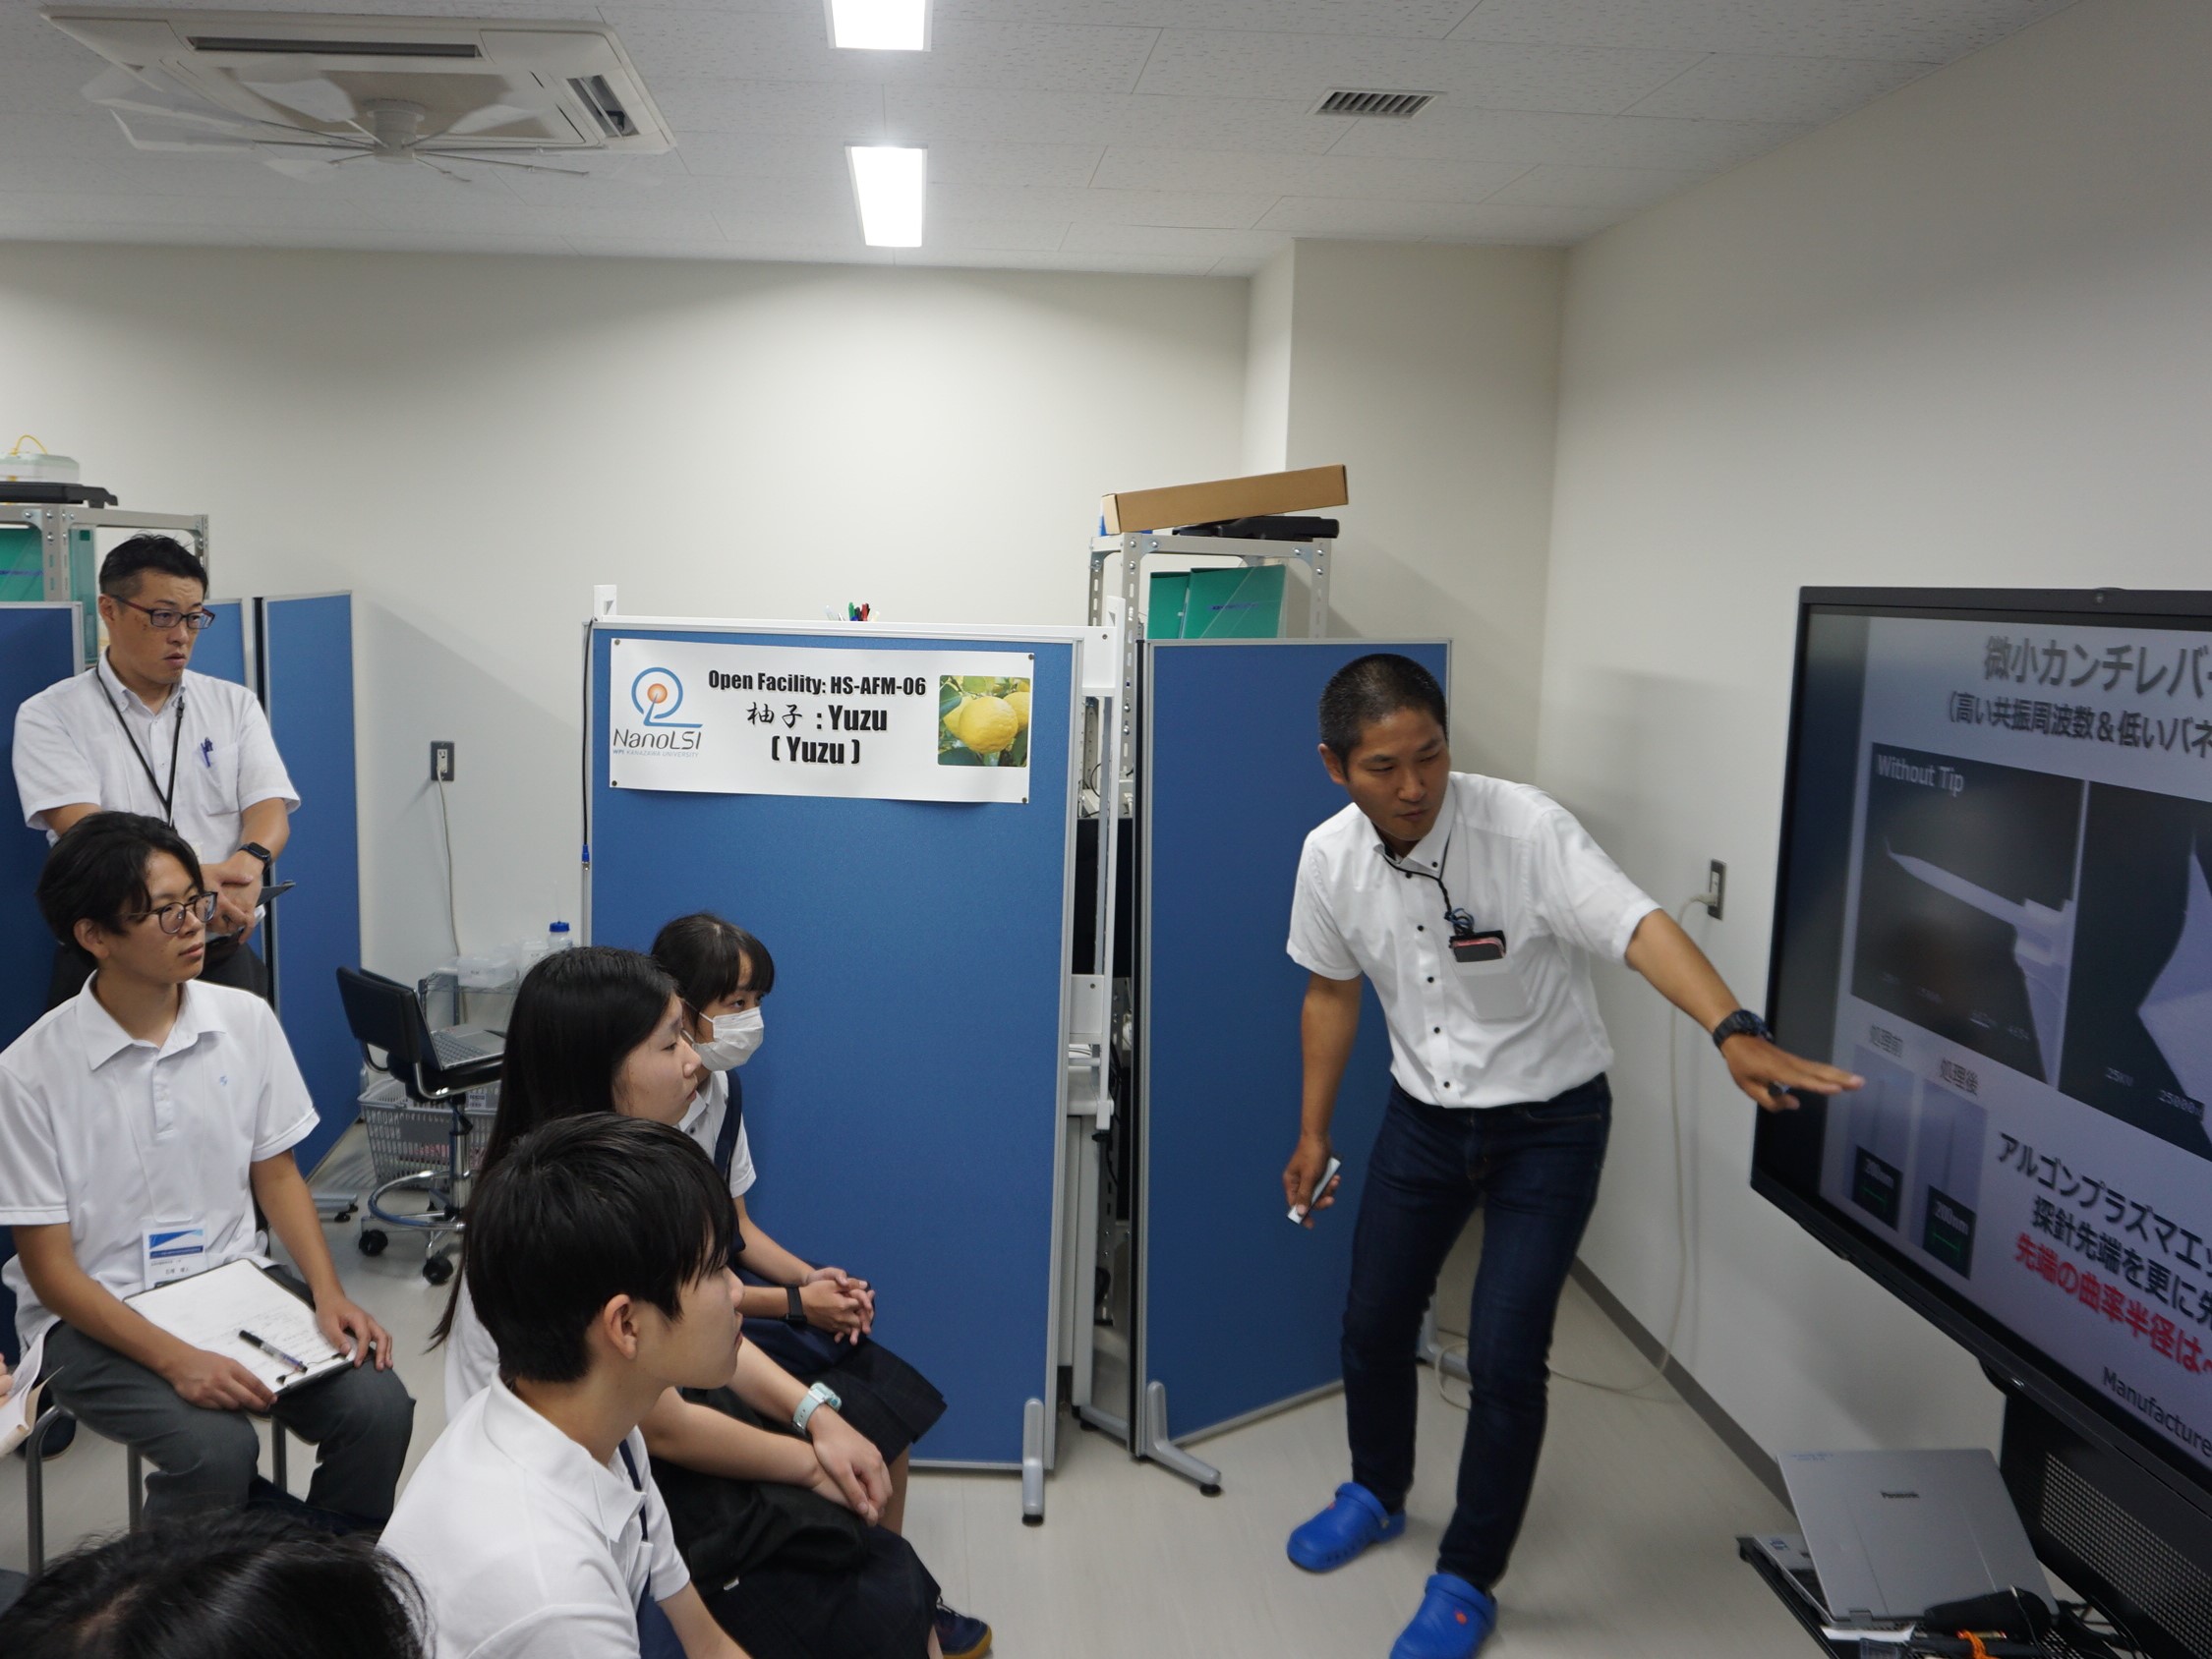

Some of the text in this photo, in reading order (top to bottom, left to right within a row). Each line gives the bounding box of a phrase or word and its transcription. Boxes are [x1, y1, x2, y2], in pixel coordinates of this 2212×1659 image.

[1984, 635, 2212, 699] 微小カンチレバ
[708, 669, 927, 696] Open Facility: HS-AFM-06
[746, 702, 803, 729] 柚子
[828, 705, 888, 732] Yuzu
[612, 728, 703, 751] NanoLSI
[1878, 754, 1964, 797] Without Tip
